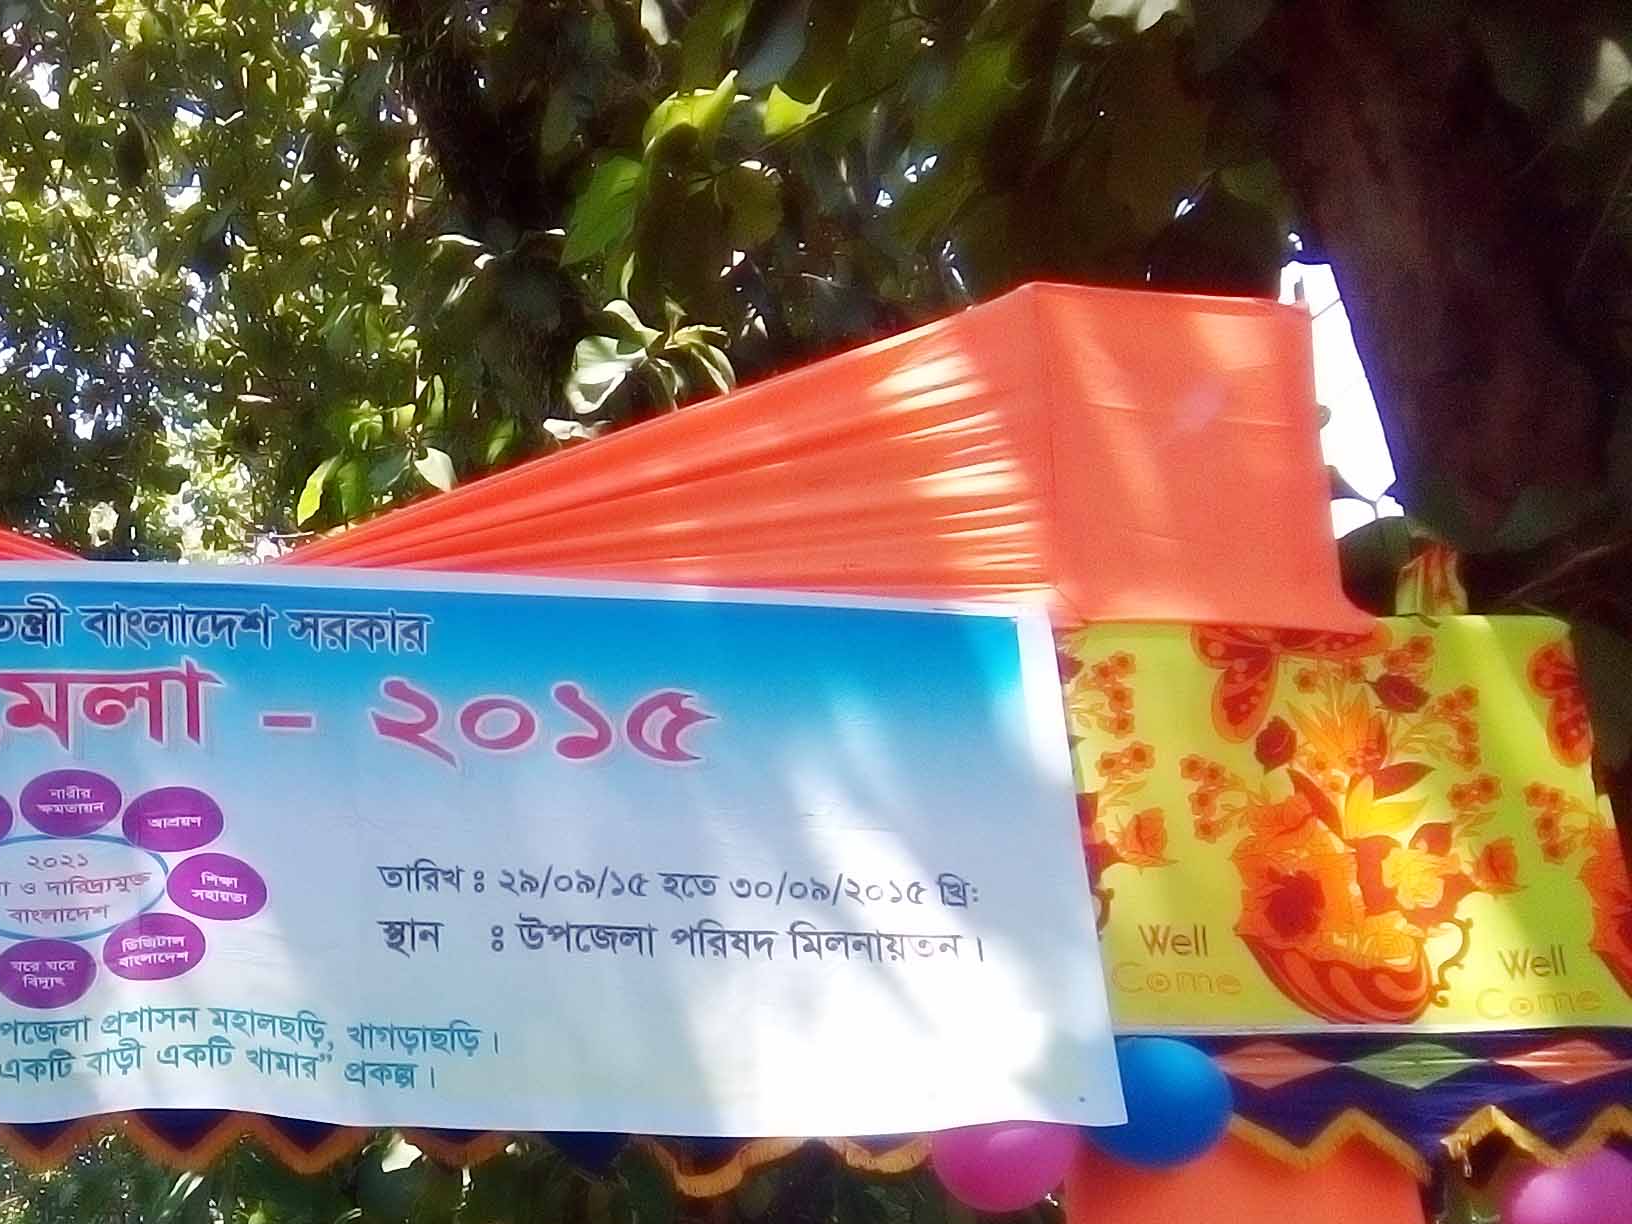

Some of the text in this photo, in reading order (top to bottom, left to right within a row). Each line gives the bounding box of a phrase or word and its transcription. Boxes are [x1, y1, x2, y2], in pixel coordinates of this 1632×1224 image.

[76, 602, 279, 650] বাংলাদেশ
[283, 608, 435, 655] সরকার
[369, 675, 718, 769] ২০১৫
[49, 785, 93, 800] নারীর
[35, 801, 105, 815] ক্ষমতায়ন
[26, 853, 89, 871] ২০২১
[20, 881, 36, 895] ও
[200, 871, 239, 889] শিক্ষা
[376, 858, 465, 893] তারিখ
[499, 864, 650, 899] ২৯/০৯/১৫
[658, 872, 720, 902] হতে
[729, 871, 927, 905] ৩০/০৯/২০১৫
[191, 888, 248, 905] সহায়তা
[5, 903, 110, 925] বাংলাদেশ
[121, 934, 186, 953] ডিজিটাল
[376, 917, 445, 959] স্থান
[514, 912, 659, 958] উপজেলা
[670, 918, 780, 960] পরিষদ
[786, 919, 964, 963] মিলনায়তন
[1137, 923, 1210, 958] Well
[9, 959, 77, 972] ঘরে ঘরে
[119, 950, 189, 969] বাংলাদেশ
[1498, 943, 1568, 979] Well
[1110, 960, 1243, 997] Come
[1474, 986, 1603, 1021] Come
[100, 1005, 200, 1038] প্রশাসন
[208, 1007, 335, 1052] মহালছড়ি,
[346, 1018, 484, 1058] খাগড়াছড়ি
[83, 1037, 148, 1077] বাড়ী
[157, 1034, 237, 1069] একটি
[343, 1059, 419, 1089] প্রকল্প
